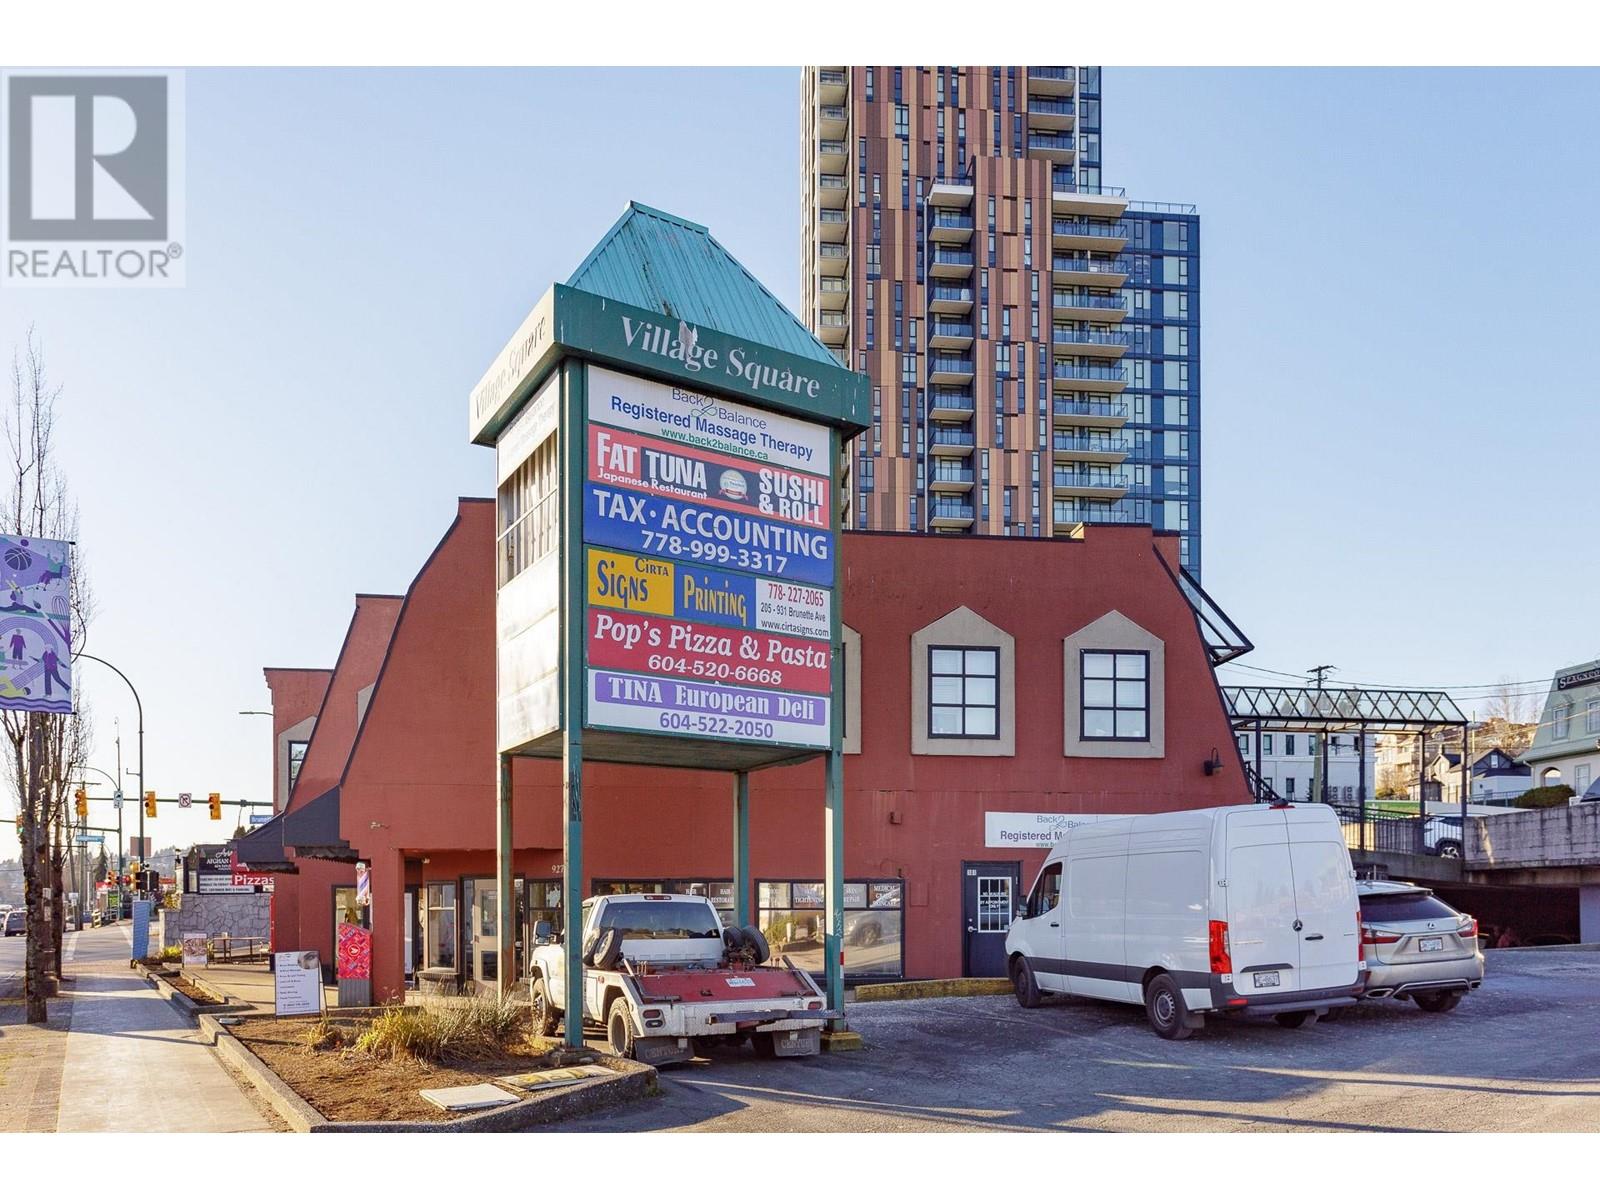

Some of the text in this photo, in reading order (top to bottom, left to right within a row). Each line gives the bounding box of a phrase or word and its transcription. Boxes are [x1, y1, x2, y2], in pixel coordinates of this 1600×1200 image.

[621, 316, 820, 398] Village Square
[611, 395, 813, 461] Registered Massage Therapy
[661, 427, 769, 460] www.back2balance.ca
[597, 432, 638, 474] FAT
[645, 450, 708, 490] TUNA
[597, 468, 649, 489] Japanese
[651, 478, 708, 500] Restaurant
[759, 467, 824, 506] SUSHI
[759, 494, 824, 526] & ROLL
[661, 504, 828, 560] ACCOUNTING
[641, 530, 788, 574] 778-999-3317
[761, 619, 829, 638] www.cirtasigns.com
[777, 604, 787, 616] 931
[788, 606, 814, 621] Brunette
[815, 611, 826, 622] Ave
[594, 614, 828, 669] Pop's Pizza & Pasta
[648, 654, 782, 685] 604-520-6668
[608, 677, 815, 720] TINA European Deli
[660, 712, 774, 738] 604-522-2050
[1000, 831, 1052, 843] Registered
[234, 874, 274, 885] Pizzas
